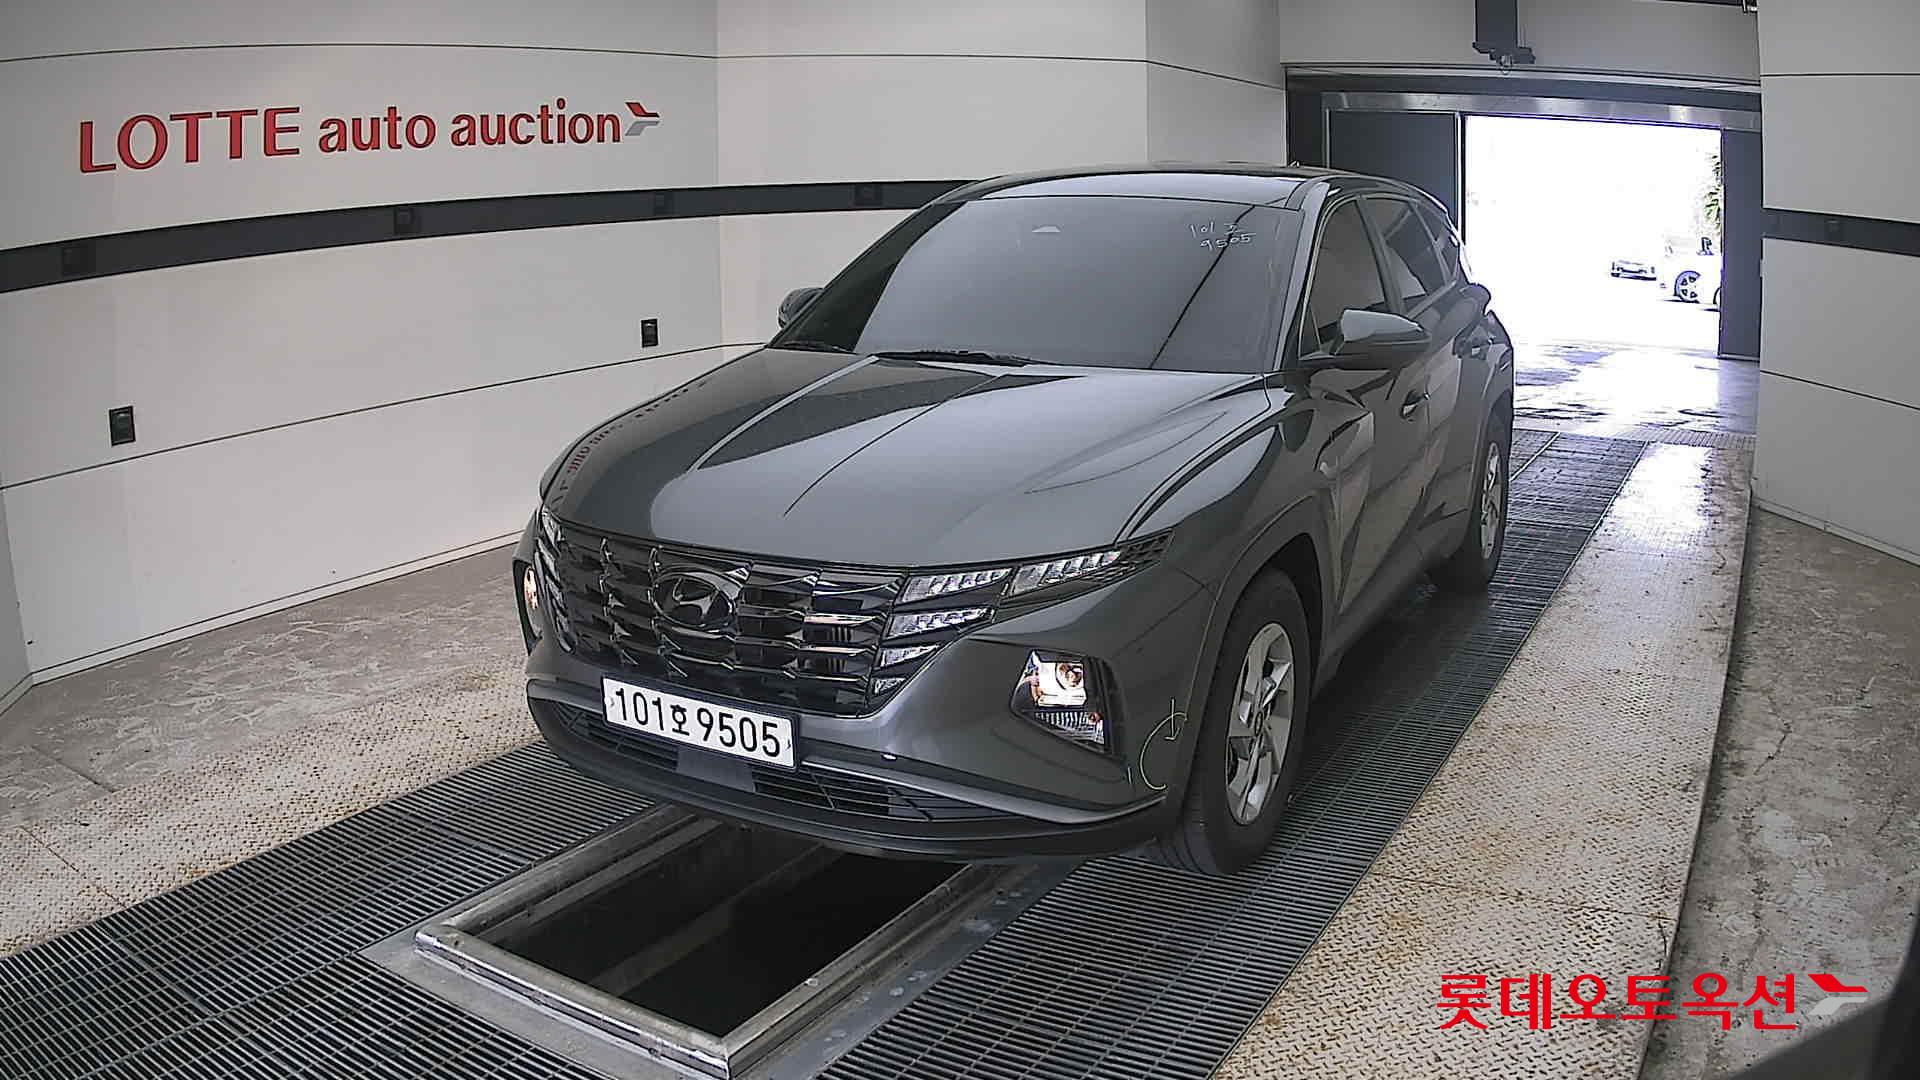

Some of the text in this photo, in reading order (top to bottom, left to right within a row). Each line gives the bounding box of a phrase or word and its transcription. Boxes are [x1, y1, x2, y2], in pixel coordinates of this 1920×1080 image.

[80, 98, 621, 173] LOTTE auto auction
[1200, 232, 1257, 251] 9505
